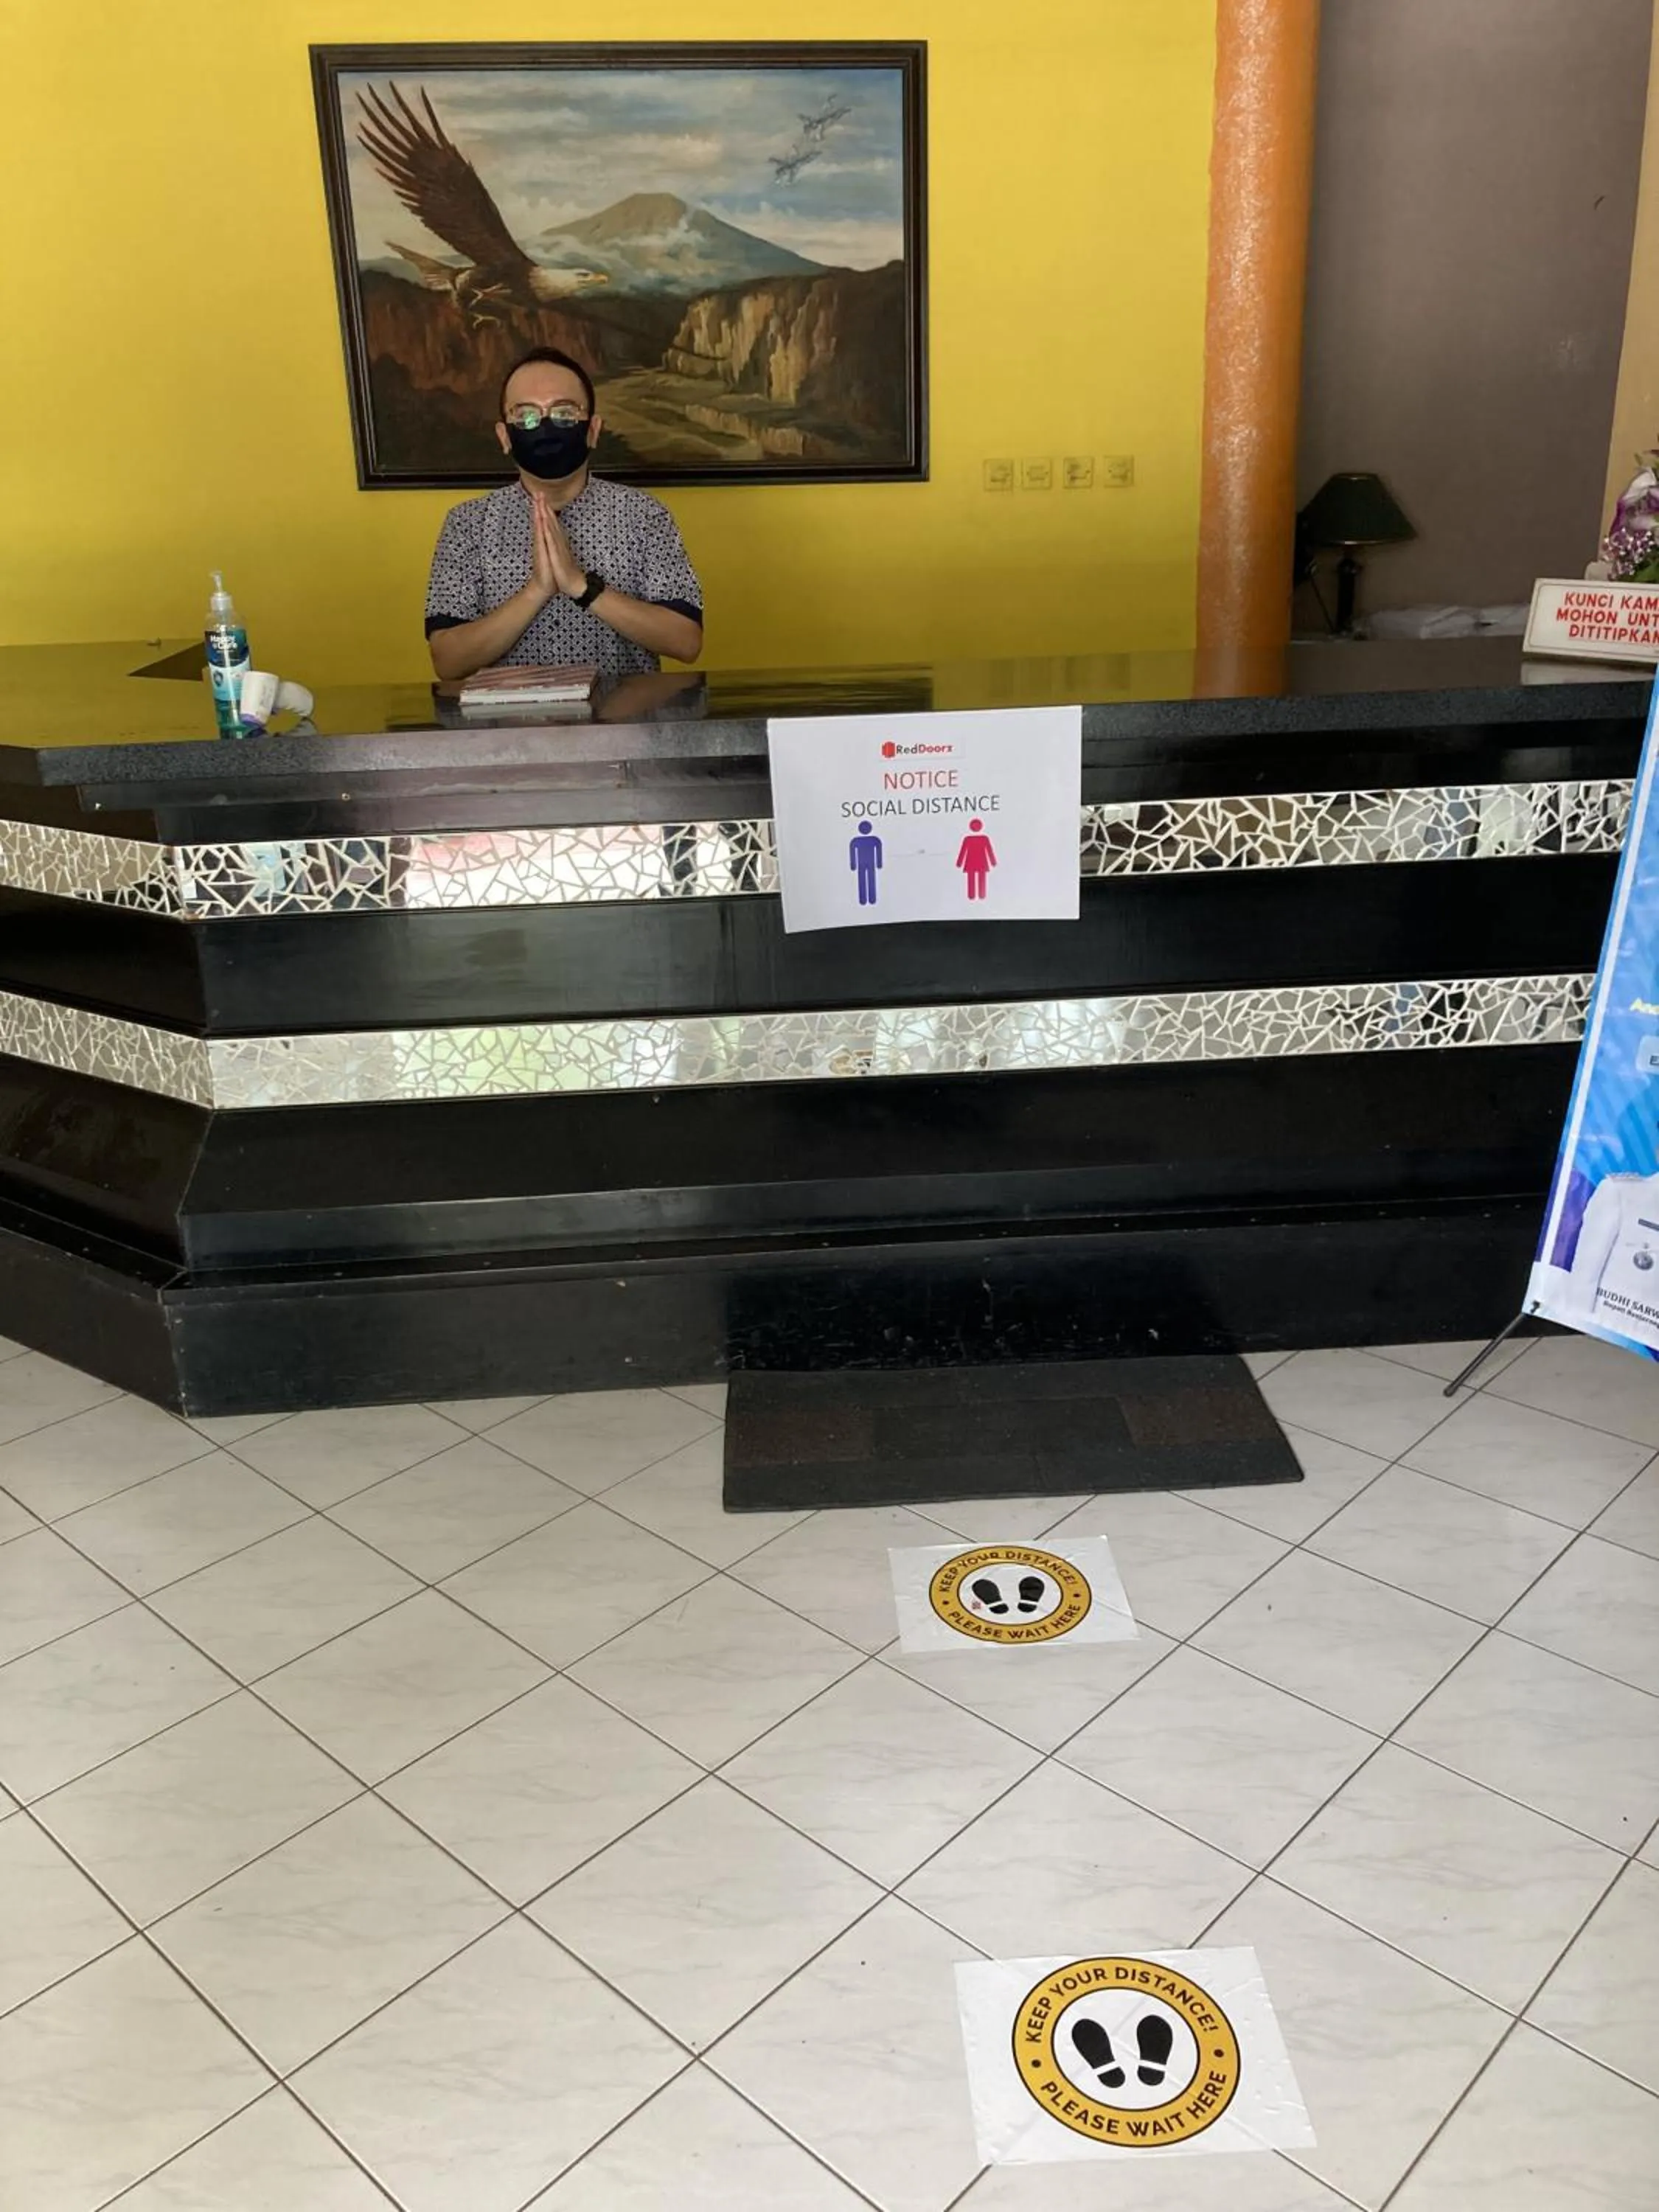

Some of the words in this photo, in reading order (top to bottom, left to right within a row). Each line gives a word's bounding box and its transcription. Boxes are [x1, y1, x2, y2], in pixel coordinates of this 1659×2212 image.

[1564, 591, 1614, 608] KUNCI
[1555, 607, 1618, 625] MOHON
[883, 769, 959, 790] NOTICE
[841, 799, 907, 818] SOCIAL
[911, 795, 1001, 815] DISTANCE
[939, 1566, 958, 1593] KEEP
[958, 1552, 1001, 1568] YOUR
[1004, 1551, 1078, 1585] DISTANCE!
[947, 1611, 1003, 1638] PLEASE
[1007, 1627, 1050, 1639] WAIT
[1051, 1604, 1081, 1630] HERE
[1026, 1996, 1053, 2044] KEEP
[1049, 1967, 1108, 1998] YOUR
[1114, 1966, 1219, 2033] DISTANCE!
[1040, 2080, 1120, 2135] PLEASE
[1127, 2112, 1186, 2137] WAIT
[1186, 2070, 1227, 2120] HERE
